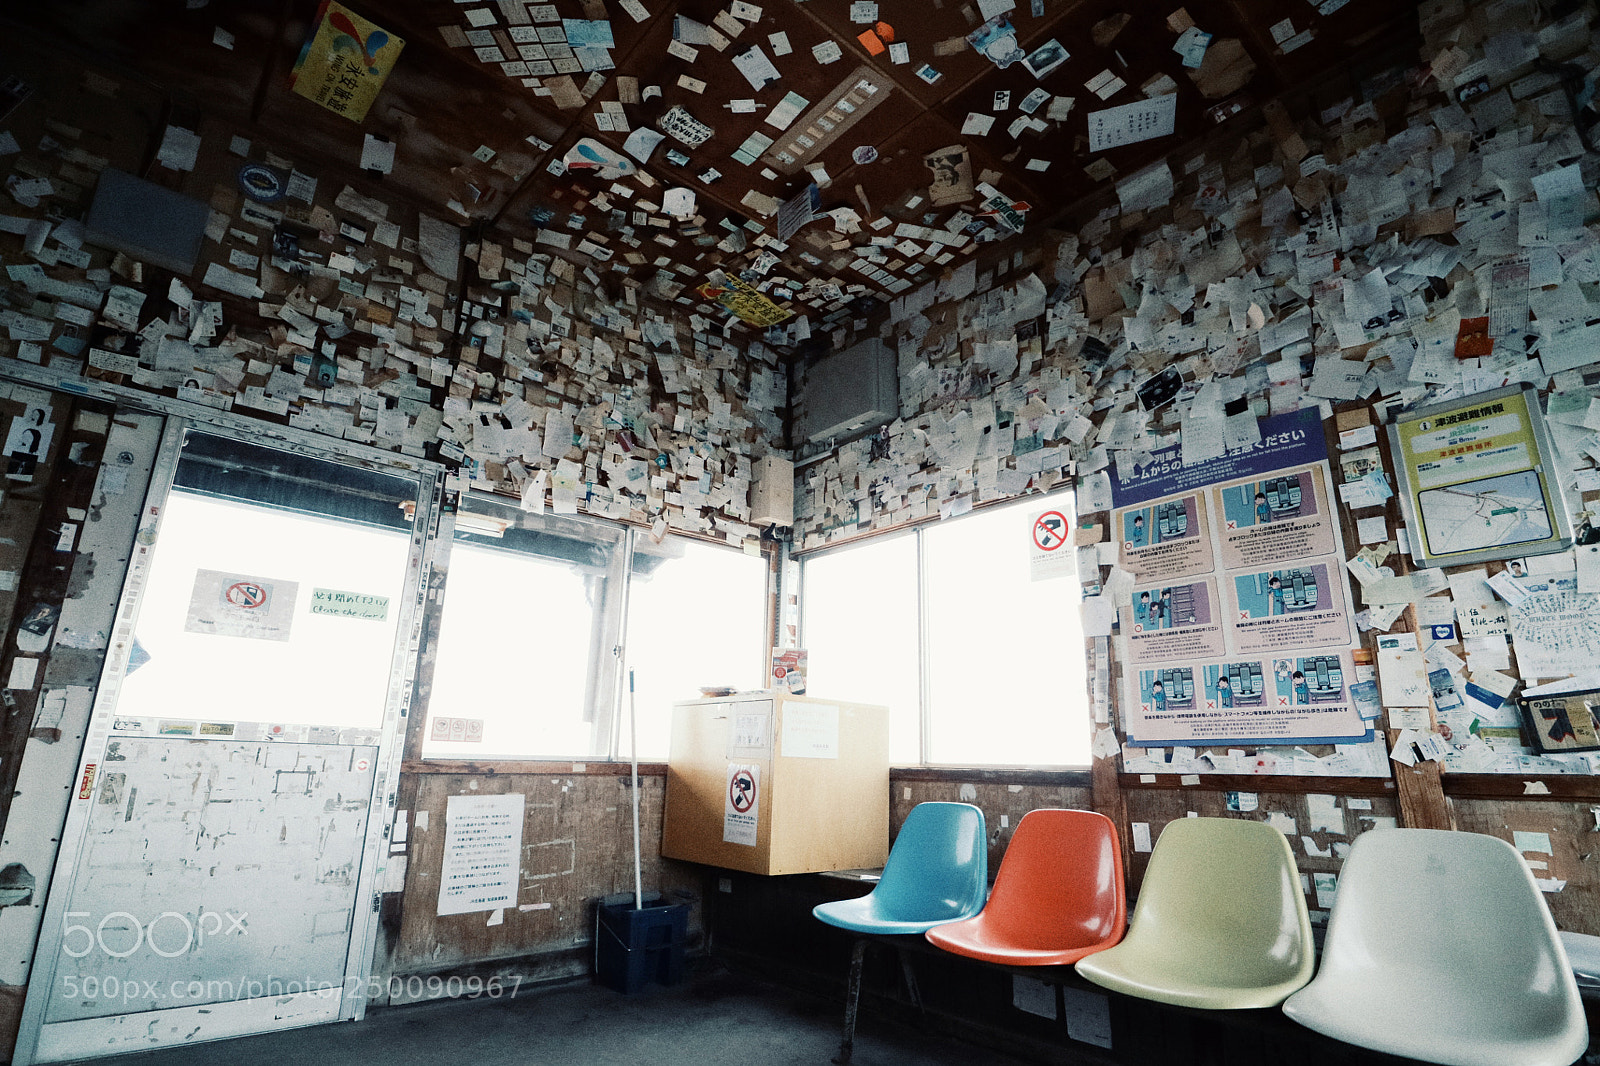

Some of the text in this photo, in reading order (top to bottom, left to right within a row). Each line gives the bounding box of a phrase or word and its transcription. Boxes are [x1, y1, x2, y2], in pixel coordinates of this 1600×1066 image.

[326, 61, 365, 112] 永安旅遊
[1434, 403, 1504, 427] 津波避難情報
[342, 607, 357, 616] the
